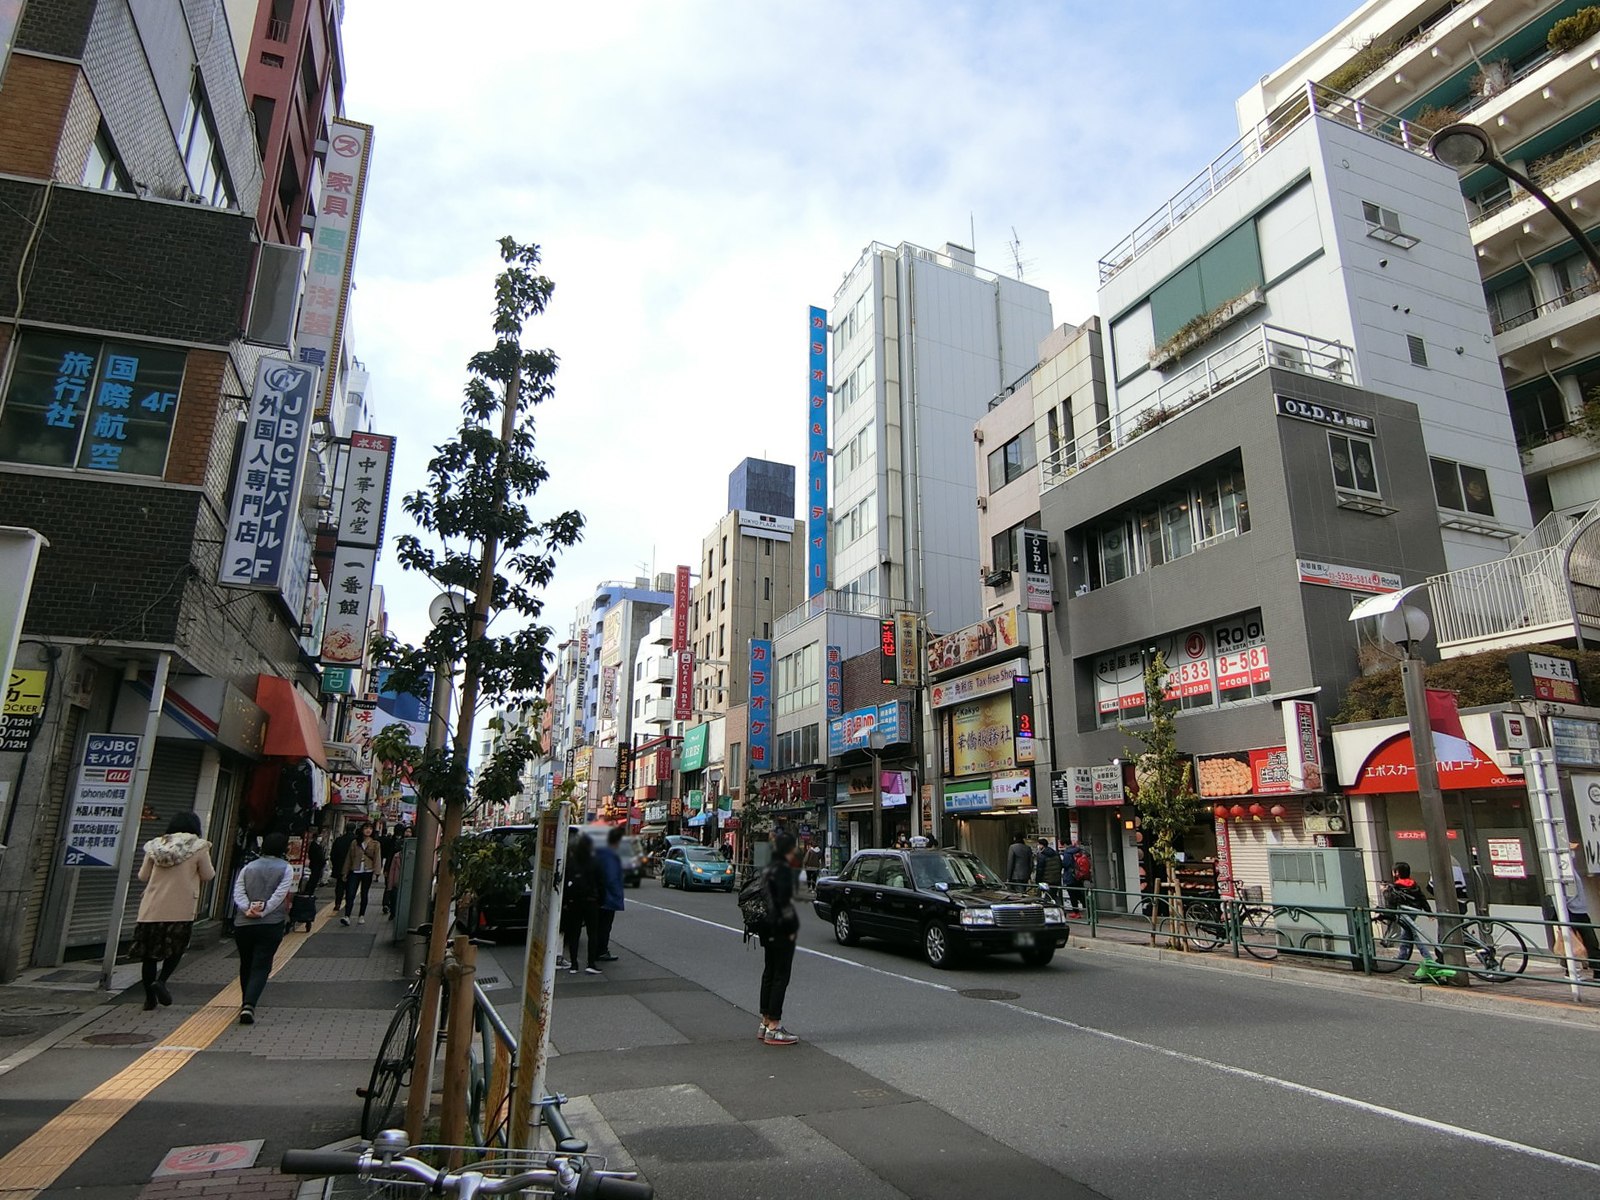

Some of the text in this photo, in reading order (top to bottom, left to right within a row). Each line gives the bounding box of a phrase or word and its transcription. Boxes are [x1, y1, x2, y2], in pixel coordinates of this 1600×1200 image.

[323, 171, 353, 218] 家具
[46, 351, 94, 429] 旅行社
[141, 391, 176, 413] 4F
[88, 355, 139, 470] 国際航空
[1285, 400, 1344, 424] OLD.L
[357, 438, 385, 450] 本格
[234, 394, 278, 544] 外国人専門店
[258, 396, 303, 550] JBCモバイル
[349, 456, 378, 535] 中華食堂
[741, 517, 759, 525] TOKYO
[760, 521, 777, 529] PLAZA
[232, 556, 272, 580] 2F
[338, 561, 366, 616] 一番館
[678, 614, 686, 648] HOTEL
[1216, 622, 1264, 647] ROO
[1000, 668, 1018, 681] Shop
[751, 647, 766, 761] カラオケ館
[1020, 714, 1030, 729] 3
[103, 741, 137, 752] JBC
[88, 753, 132, 765] モバイル
[107, 771, 130, 780] au
[954, 794, 988, 808] FamilyMart
[66, 853, 85, 865] 2F
